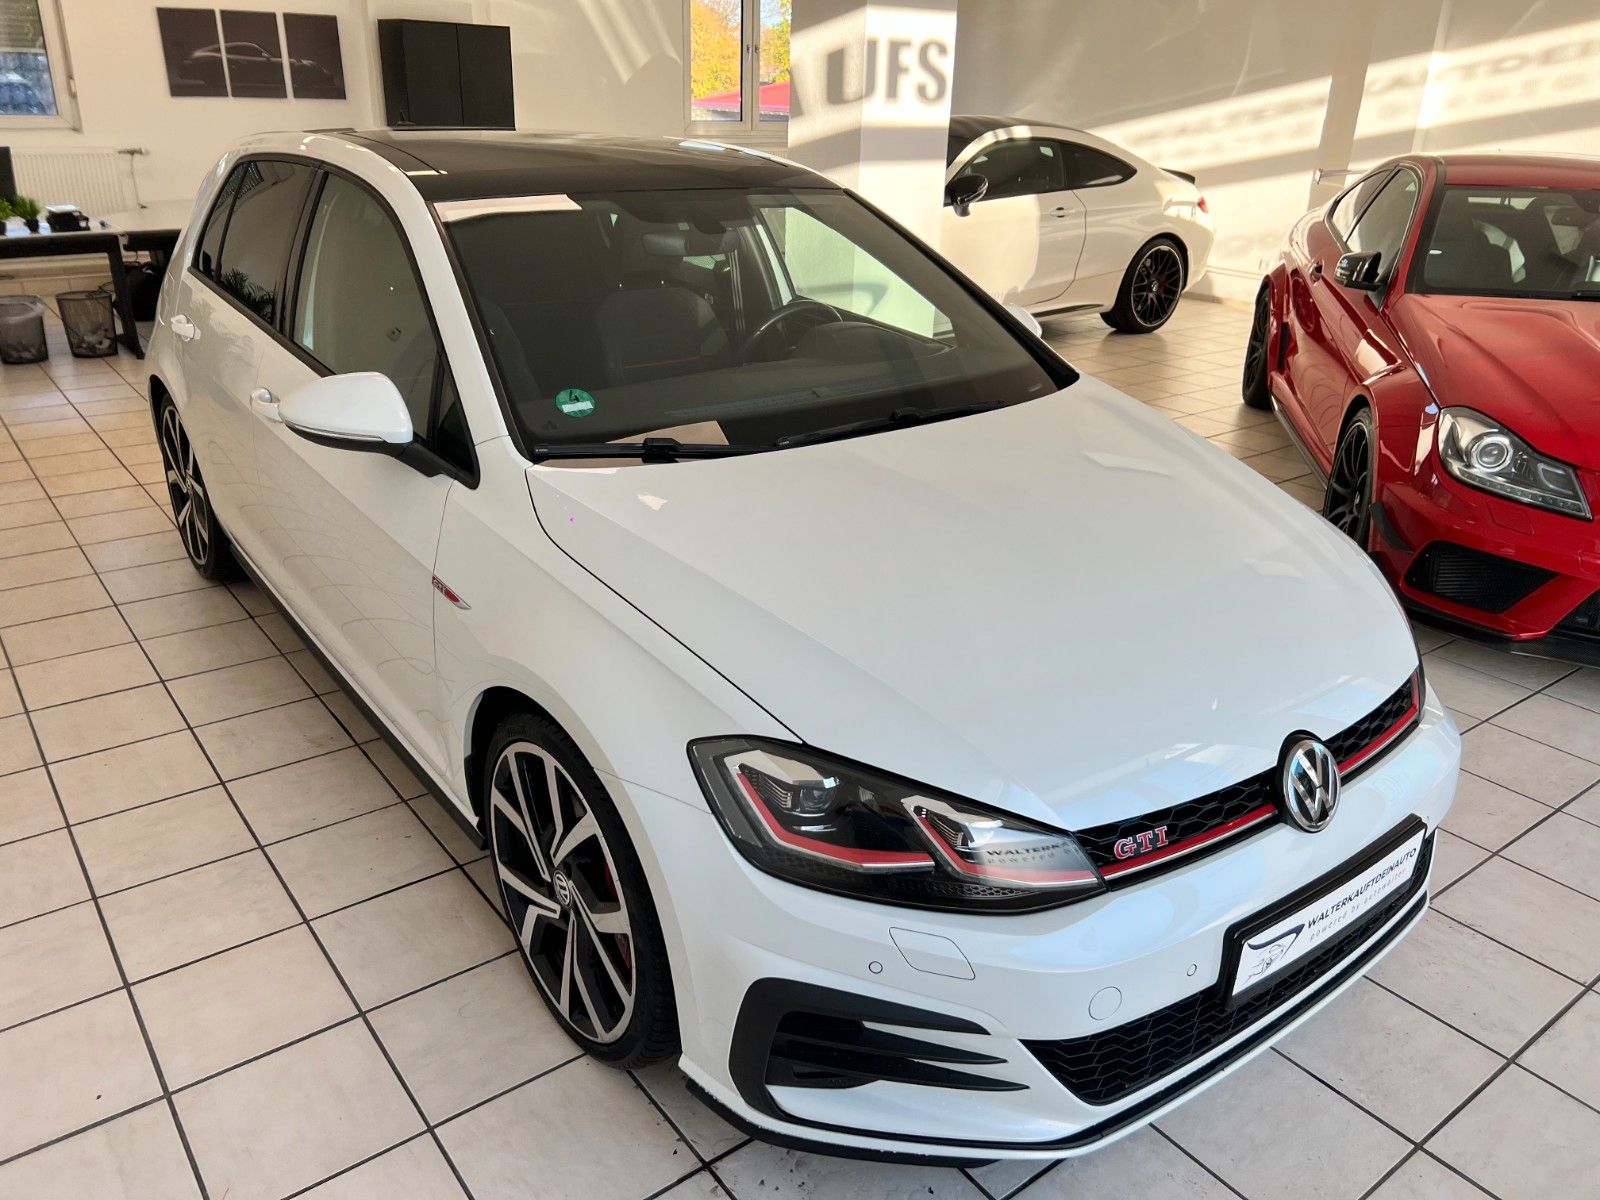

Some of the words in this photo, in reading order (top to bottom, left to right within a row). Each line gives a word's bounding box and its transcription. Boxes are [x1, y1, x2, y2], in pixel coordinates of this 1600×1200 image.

[791, 38, 948, 114] UFS
[1113, 825, 1169, 860] GTI
[1307, 847, 1418, 929] WALTERKAUFTDEINAUTO
